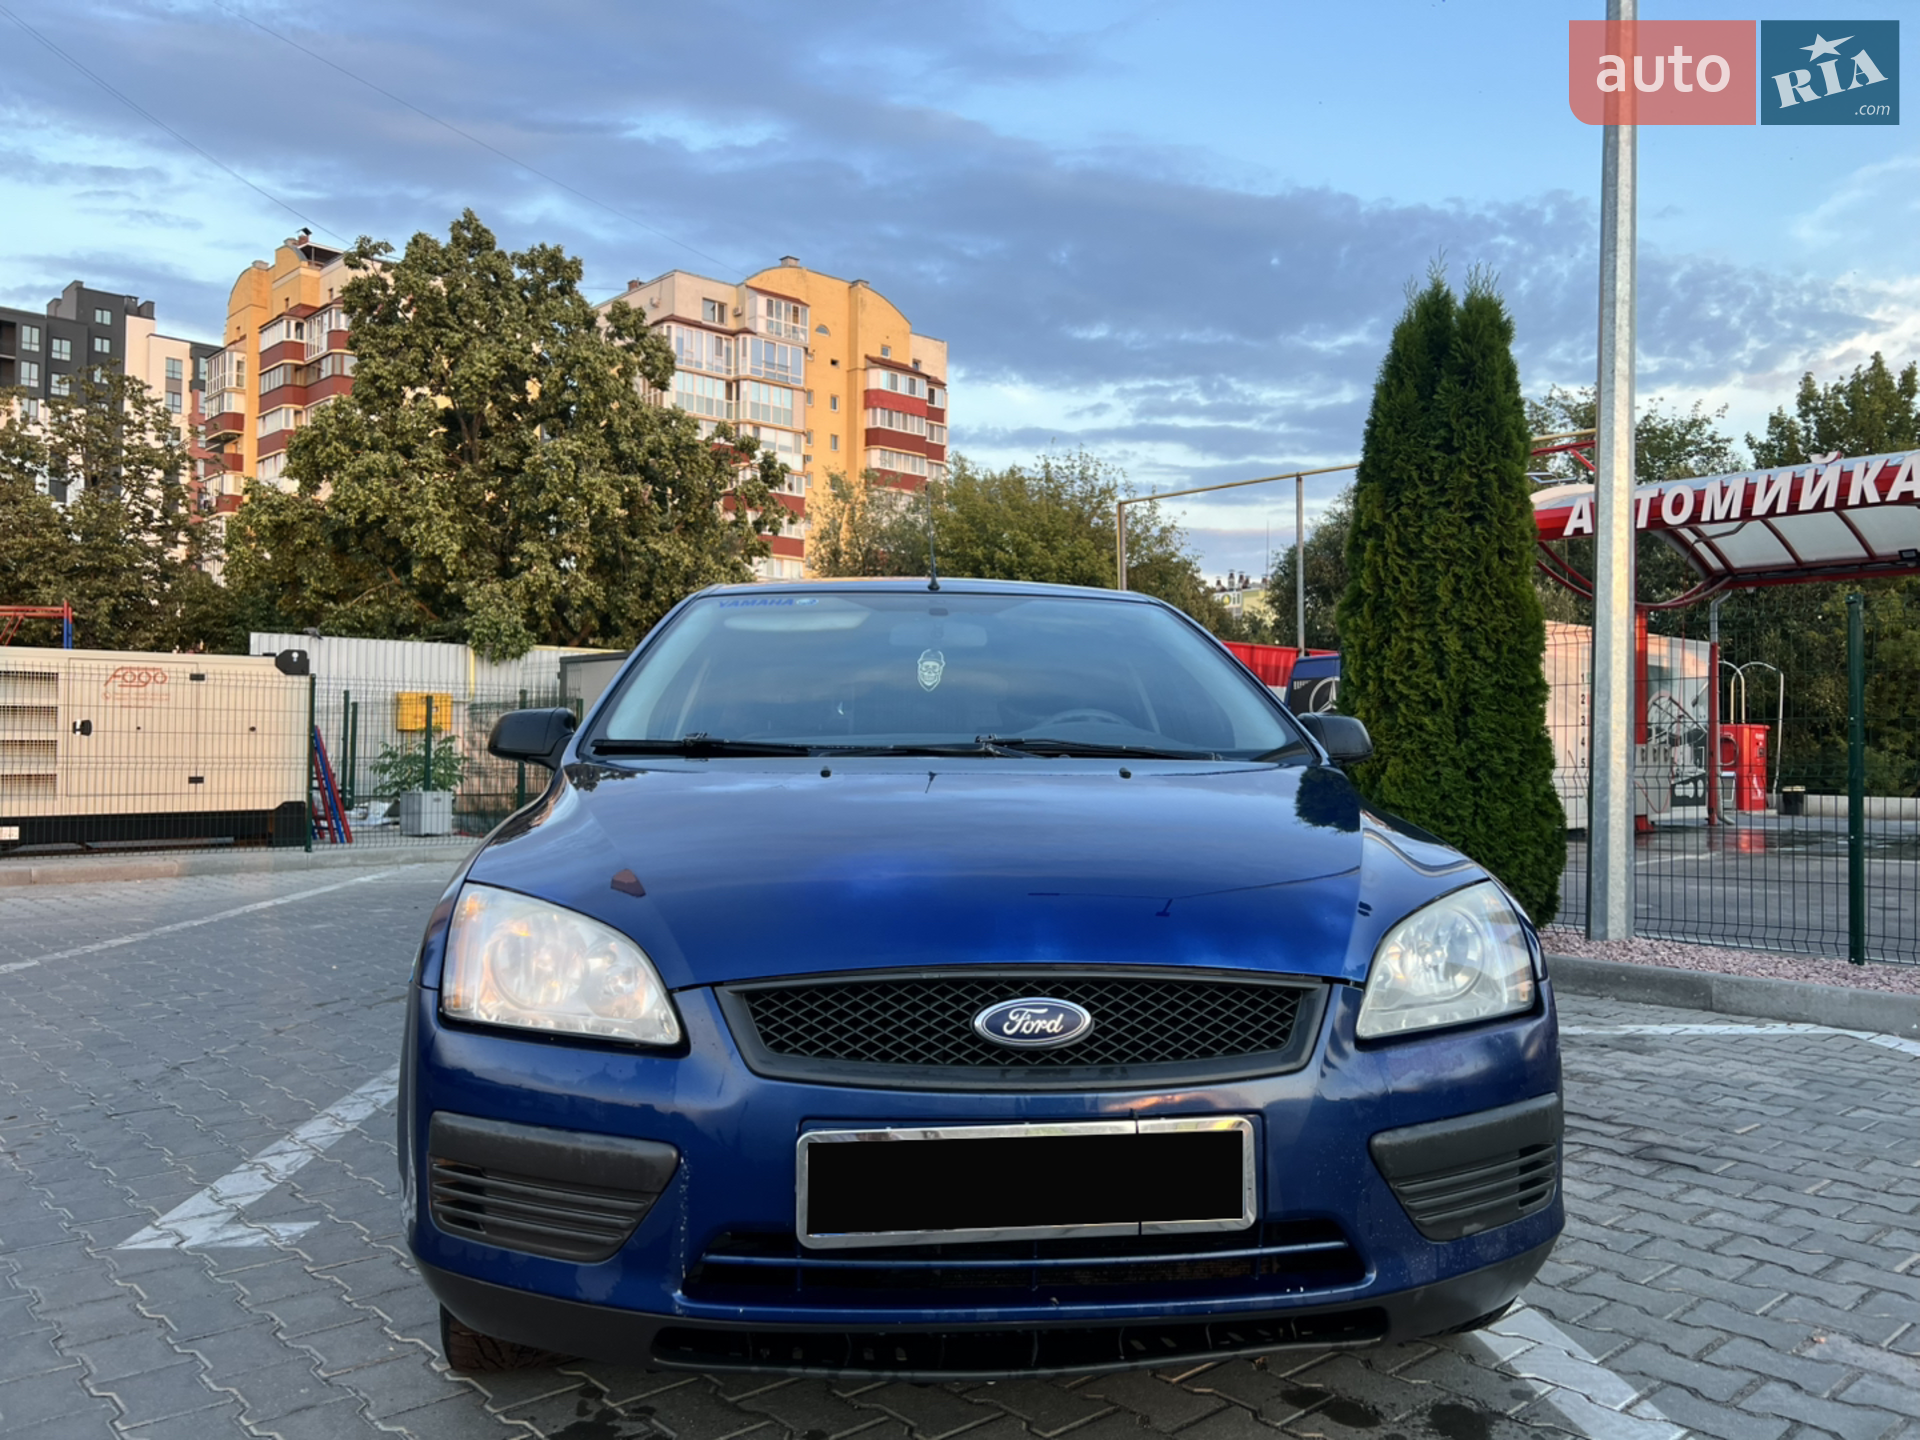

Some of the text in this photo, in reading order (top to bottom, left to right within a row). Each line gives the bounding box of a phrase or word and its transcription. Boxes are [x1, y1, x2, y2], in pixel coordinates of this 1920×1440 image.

[1563, 450, 1920, 537] АТОМИЙКА
[719, 598, 795, 608] YAMAHA
[1580, 693, 1586, 705] 2
[1580, 736, 1586, 747] 4
[1580, 757, 1586, 769] 5
[1003, 1008, 1064, 1035] Ford
